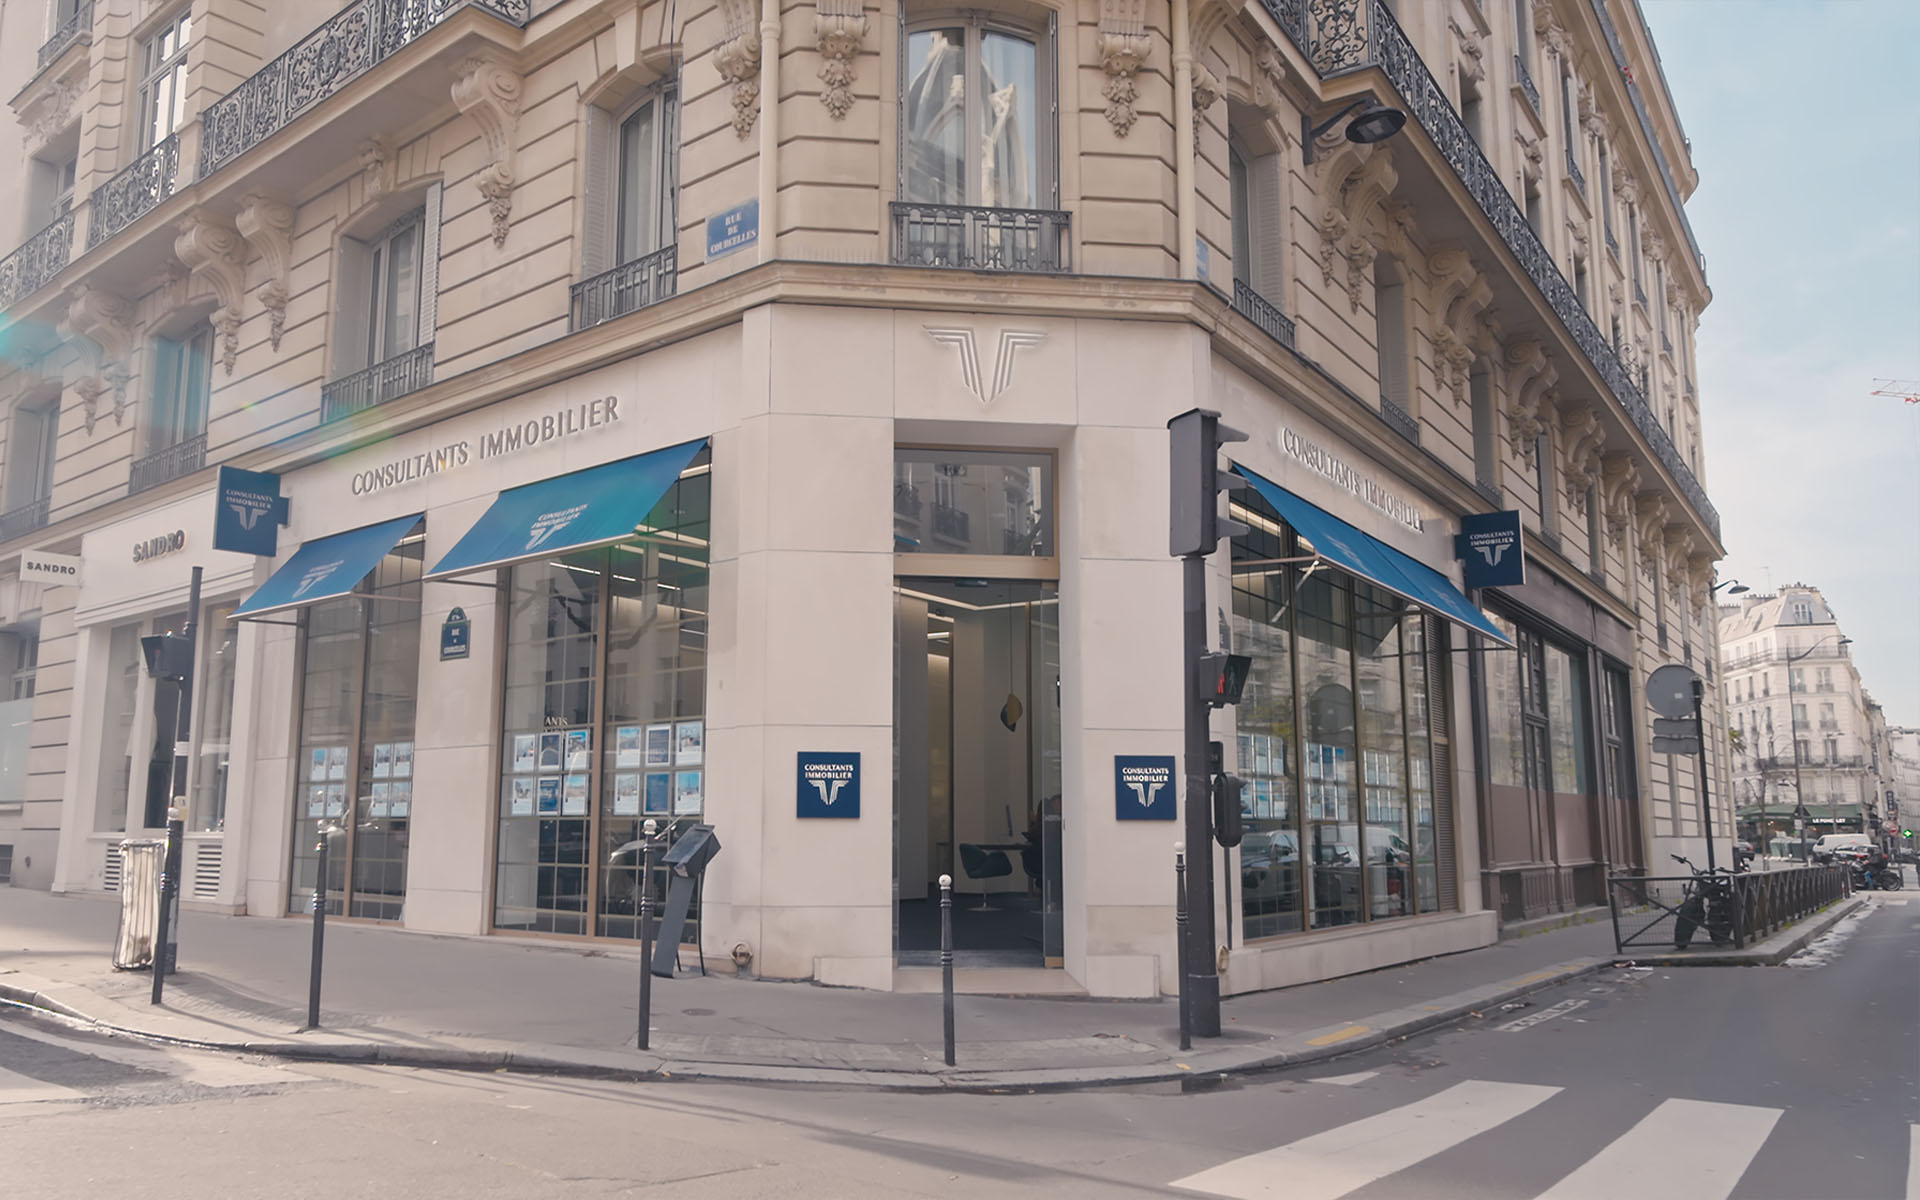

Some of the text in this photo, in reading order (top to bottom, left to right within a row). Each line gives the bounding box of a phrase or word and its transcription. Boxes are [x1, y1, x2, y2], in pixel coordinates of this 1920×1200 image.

[725, 212, 741, 226] RUE
[727, 224, 738, 235] DE
[351, 395, 619, 496] CONSULTANTS IMMOBILIER
[1281, 427, 1361, 495] CONSULTANTS
[225, 488, 273, 503] CONSULTANTS
[226, 496, 272, 509] IMMOBILIER
[1469, 530, 1515, 540] CONSULTANTS
[132, 529, 186, 563] SANDRO
[1470, 537, 1514, 546] IMMOBILIER
[26, 561, 76, 576] SANDRO
[804, 763, 854, 771] CONSULTANTS
[1122, 767, 1170, 775] CONSULTANTS
[804, 771, 853, 779] IMMOBILIER
[1122, 774, 1169, 782] IMMOBILIER
